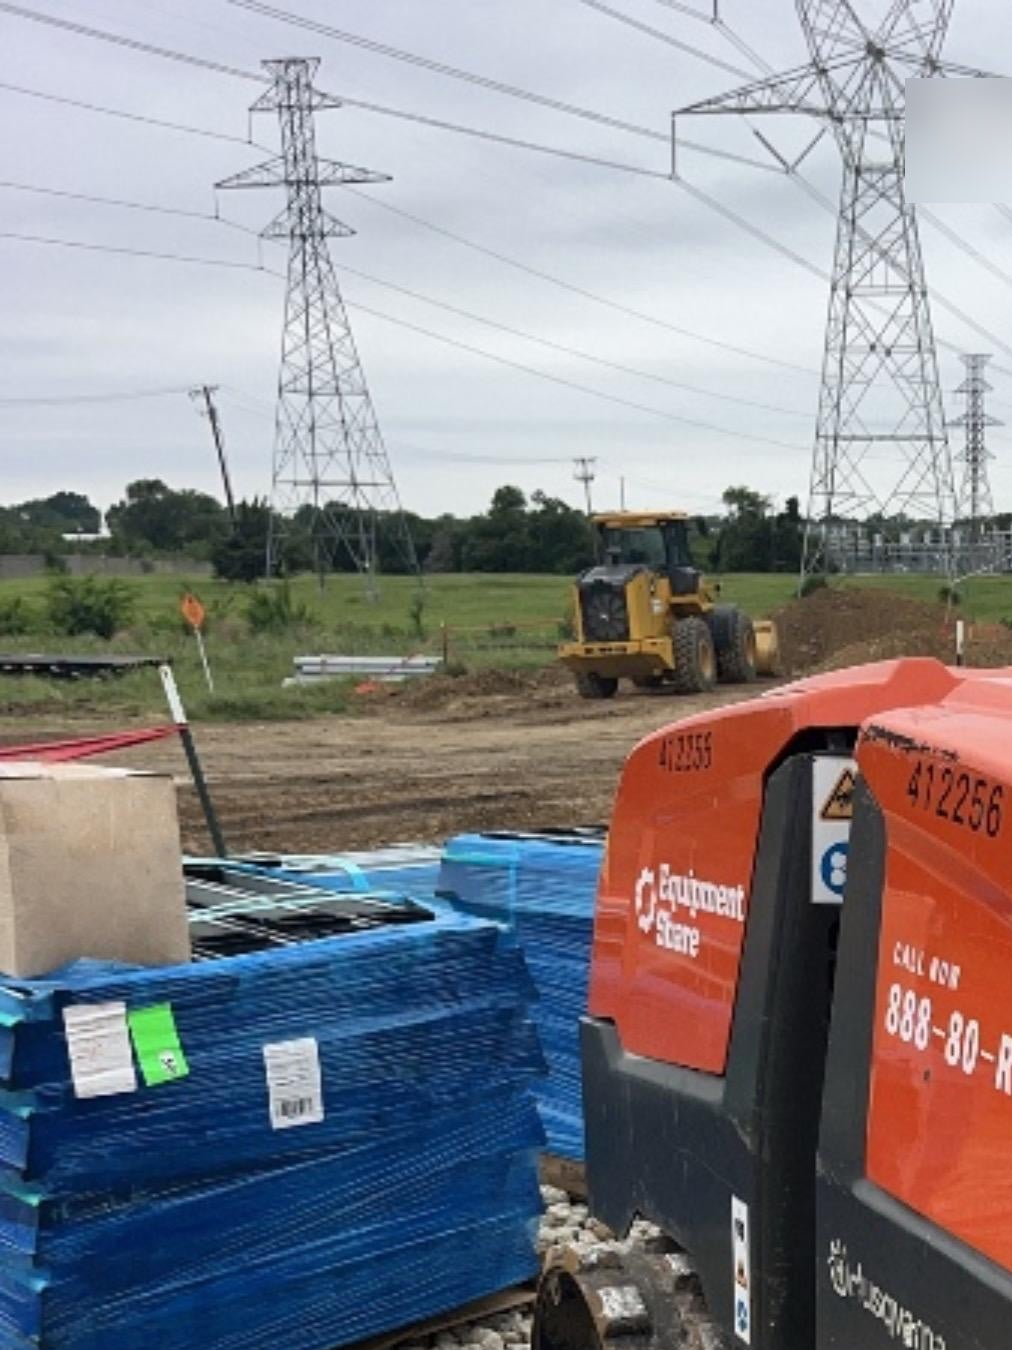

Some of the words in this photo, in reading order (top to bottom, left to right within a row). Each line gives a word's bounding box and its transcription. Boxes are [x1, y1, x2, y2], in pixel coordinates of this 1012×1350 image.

[908, 760, 1004, 838] 412256
[659, 863, 745, 922] Equipment
[656, 909, 700, 958] Share
[893, 941, 925, 977] CALL
